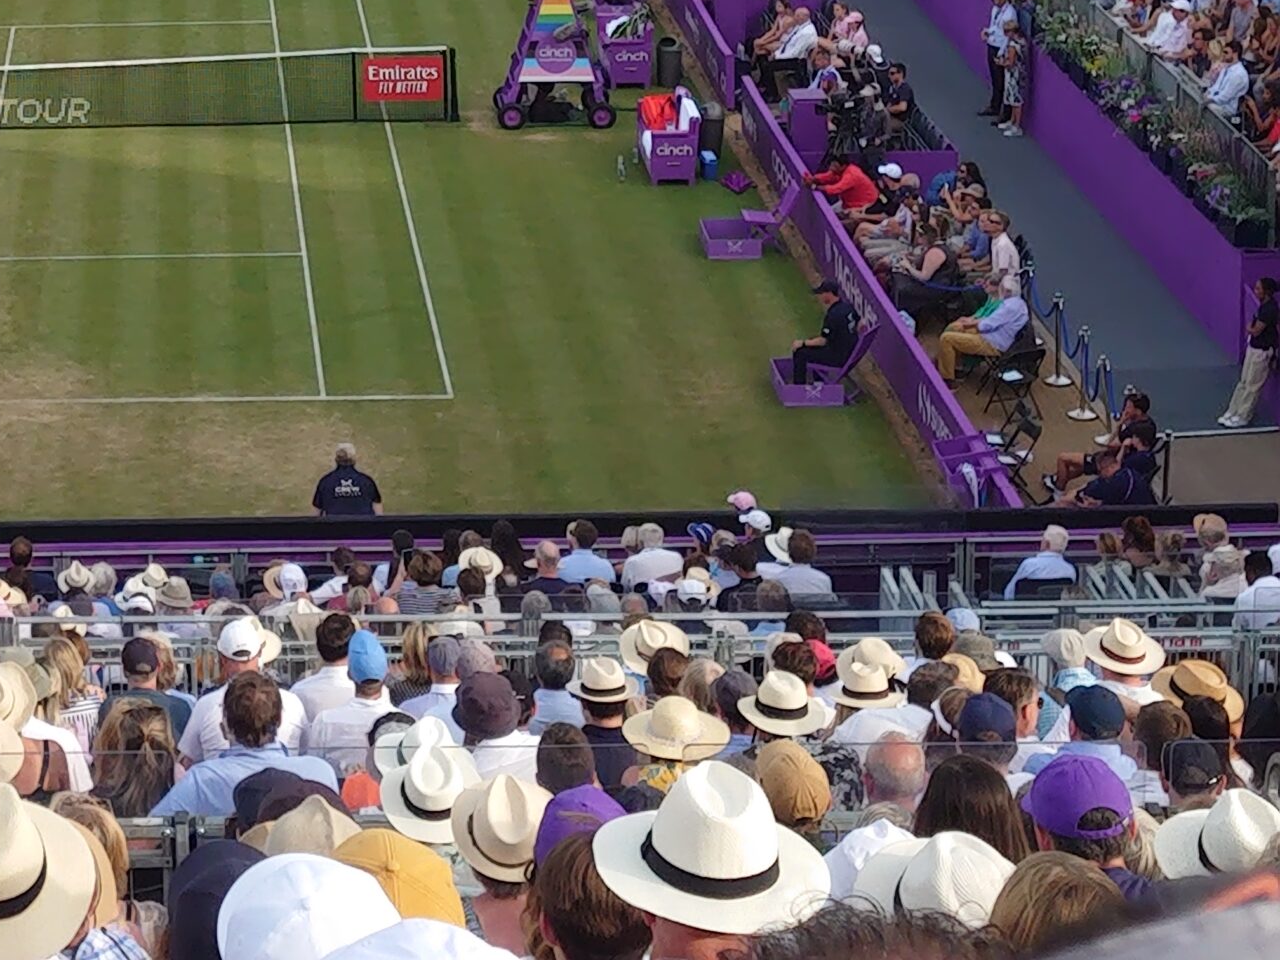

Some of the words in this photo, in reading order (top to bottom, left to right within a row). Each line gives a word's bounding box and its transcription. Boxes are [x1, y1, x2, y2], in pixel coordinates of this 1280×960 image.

[539, 44, 573, 58] cinch
[615, 49, 648, 62] cinch
[367, 65, 439, 81] Emirates
[378, 81, 394, 94] FLY
[395, 80, 429, 93] BETTER
[656, 142, 693, 157] cinch
